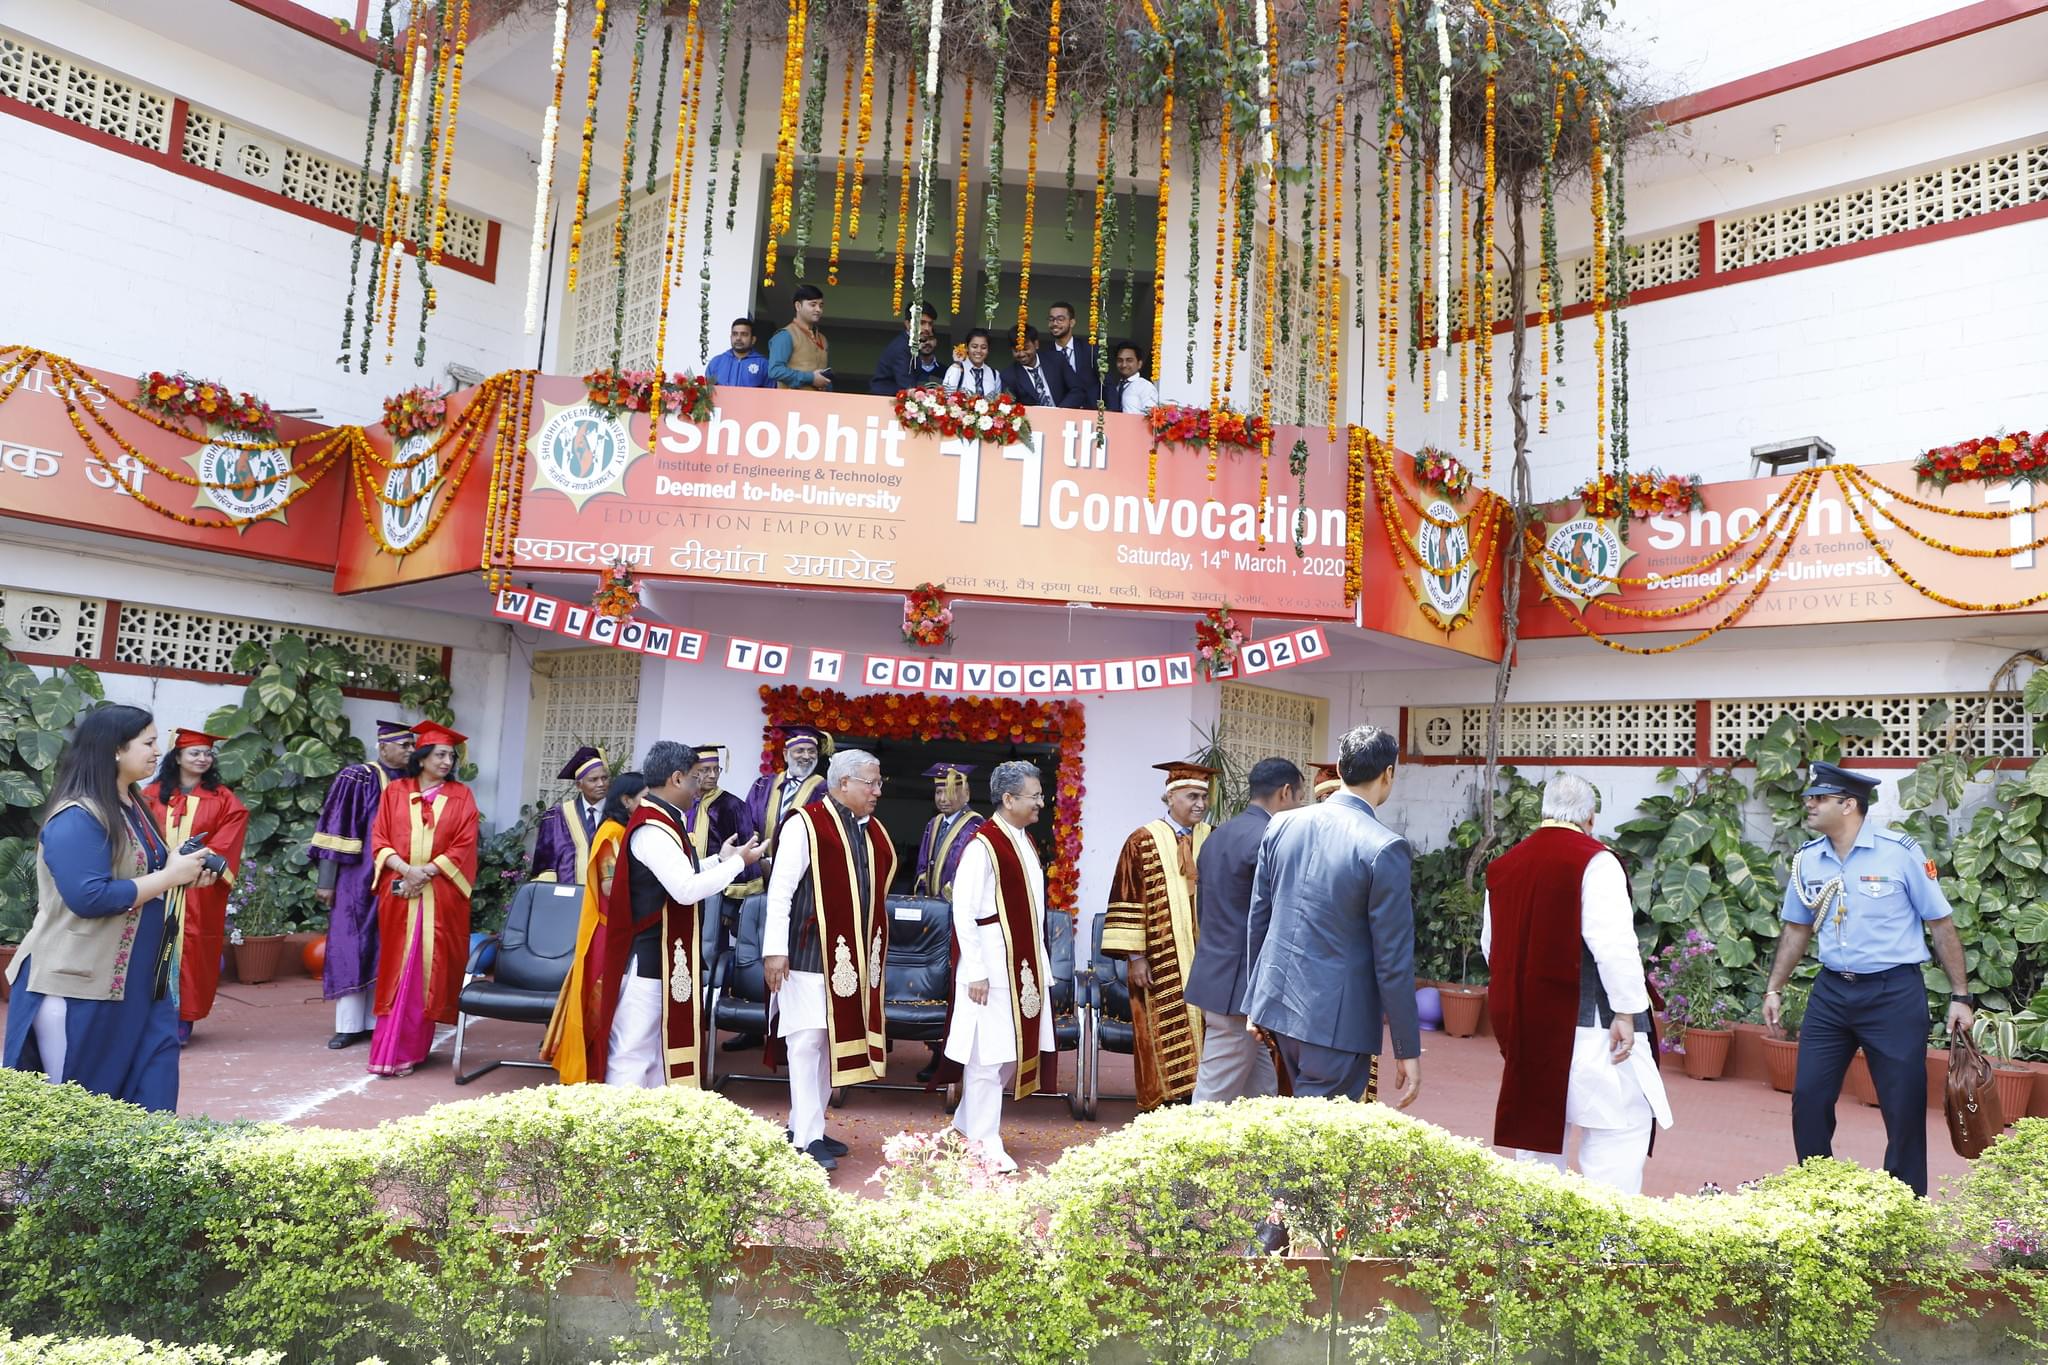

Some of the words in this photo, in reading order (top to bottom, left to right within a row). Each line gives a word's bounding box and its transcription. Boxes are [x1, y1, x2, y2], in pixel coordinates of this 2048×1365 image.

[541, 420, 563, 460] SHOBHIT
[602, 412, 627, 466] UIVERSITY
[661, 407, 906, 467] Shobhit
[655, 475, 737, 499] Deemed
[742, 480, 902, 513] to-be-University
[657, 458, 712, 473] Institute
[715, 462, 730, 474] of
[733, 463, 811, 481] Engineering
[814, 467, 826, 480] &
[830, 468, 903, 487] Technology
[603, 507, 751, 531] EDUCATION
[762, 517, 898, 541] EMPOWERS
[1049, 479, 1346, 547] Convocation
[670, 539, 767, 575] दीक्षांत
[784, 549, 898, 585] समारोह
[1116, 544, 1194, 571] Saturday,
[1234, 554, 1287, 574] March
[1302, 556, 1346, 578] 2020
[500, 592, 698, 655] WELCOME
[734, 644, 783, 669] TO
[814, 657, 838, 676] 11
